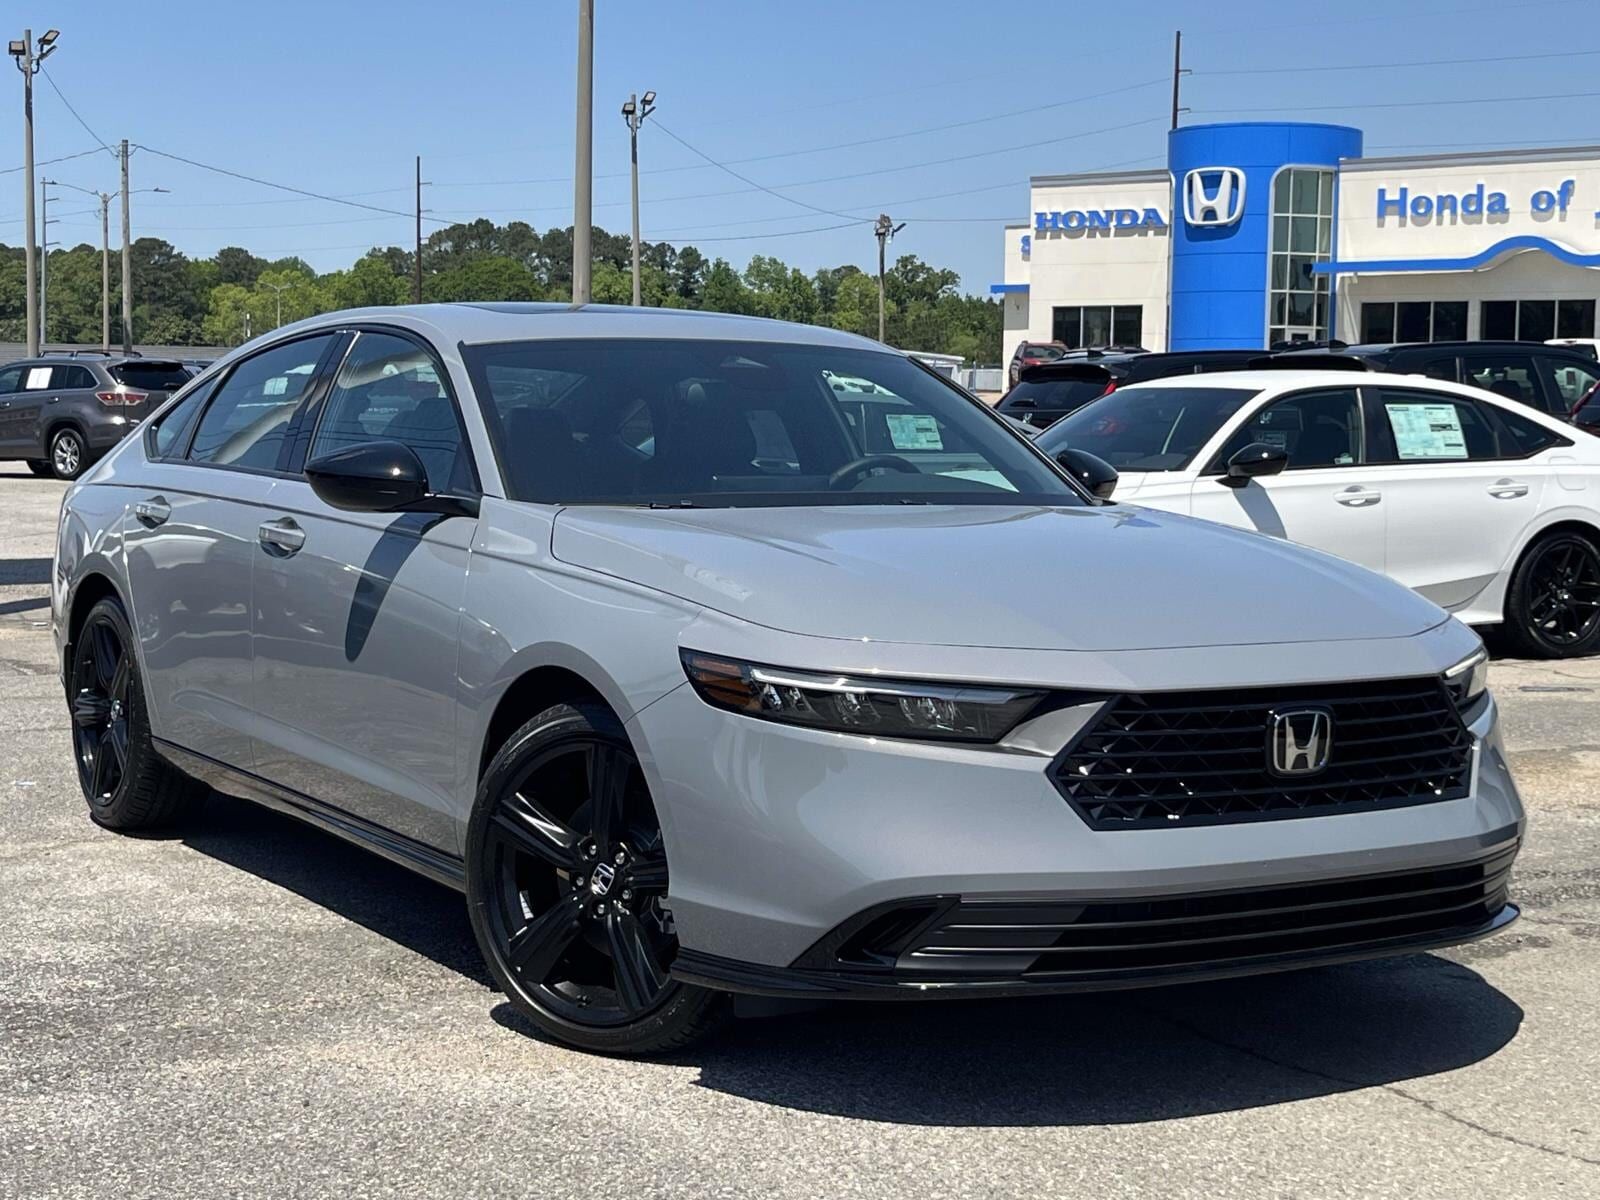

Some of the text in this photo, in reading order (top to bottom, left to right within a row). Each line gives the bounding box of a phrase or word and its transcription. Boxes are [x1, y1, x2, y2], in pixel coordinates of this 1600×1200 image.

[1377, 179, 1575, 218] Honda of
[1034, 208, 1167, 231] HONDA
